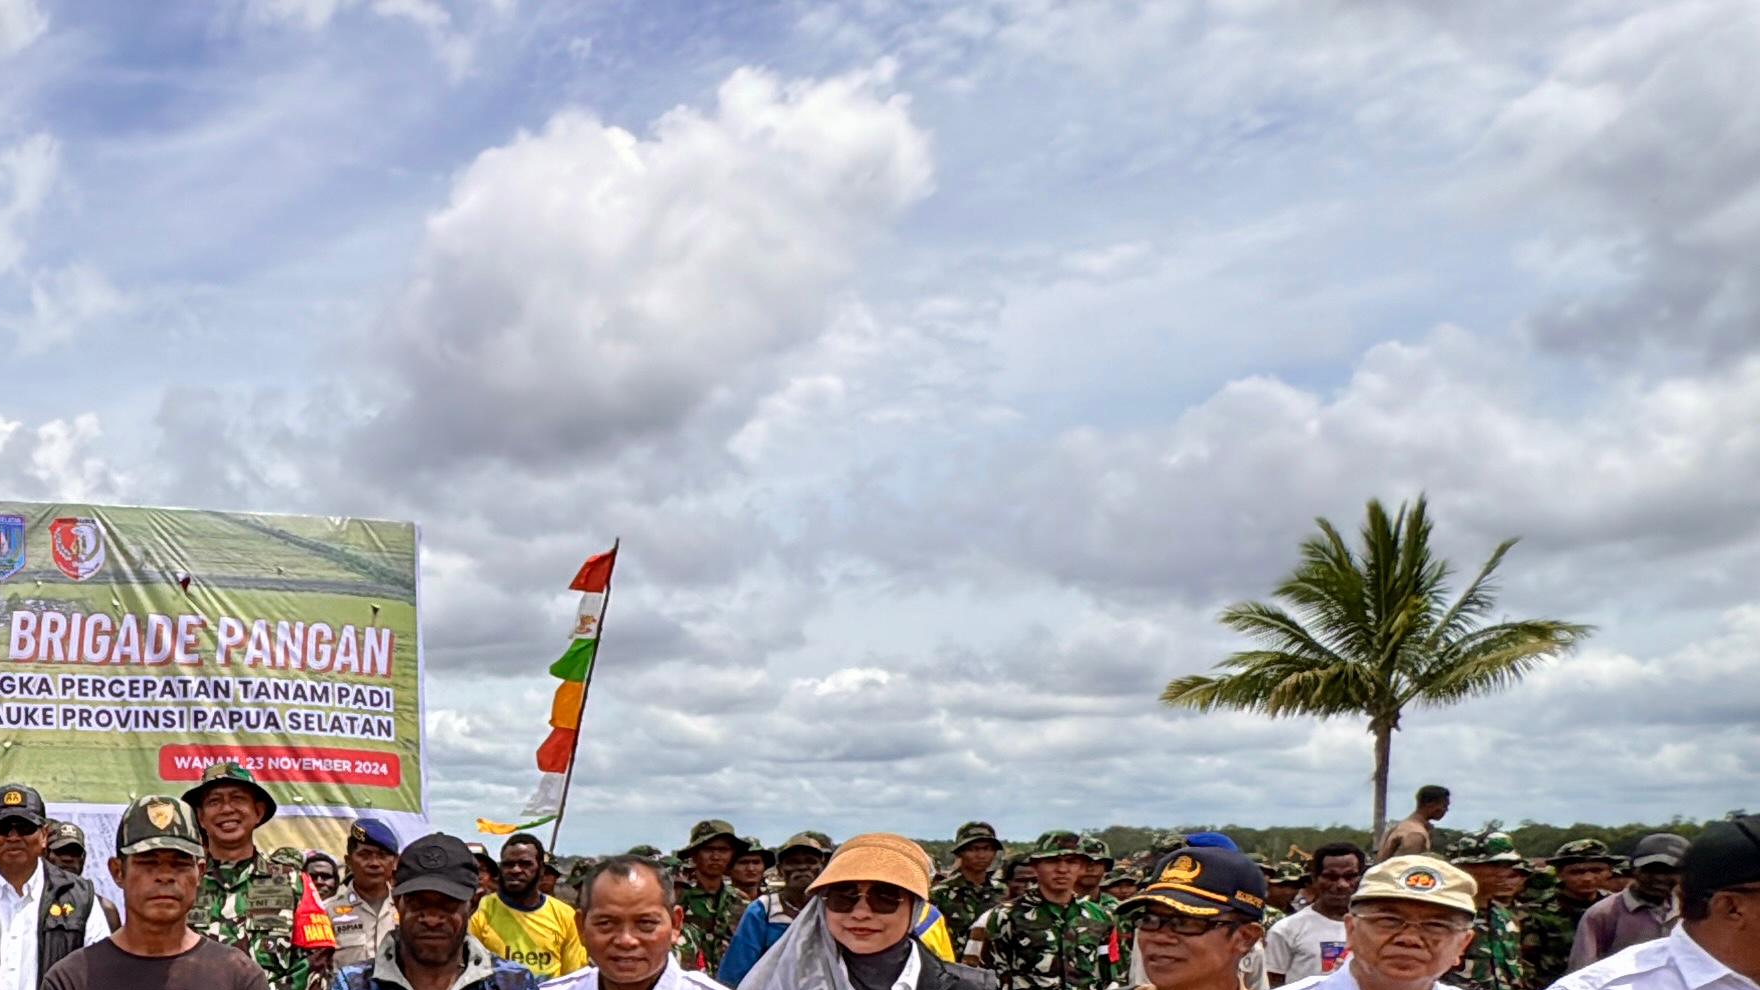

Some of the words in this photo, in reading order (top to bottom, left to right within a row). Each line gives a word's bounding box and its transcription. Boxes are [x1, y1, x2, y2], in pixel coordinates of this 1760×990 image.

[8, 609, 204, 665] BRIGADE
[215, 616, 392, 675] PANGAN
[60, 677, 230, 699] PERCEPATAN
[239, 680, 330, 705] TANAM
[337, 686, 391, 709] PADI
[61, 707, 185, 729] PROVINSI
[193, 709, 281, 731] PAPUA
[287, 712, 392, 738] SELATAN
[245, 755, 264, 770] 23
[267, 757, 352, 773] NOVEMBER
[354, 760, 389, 776] 2024
